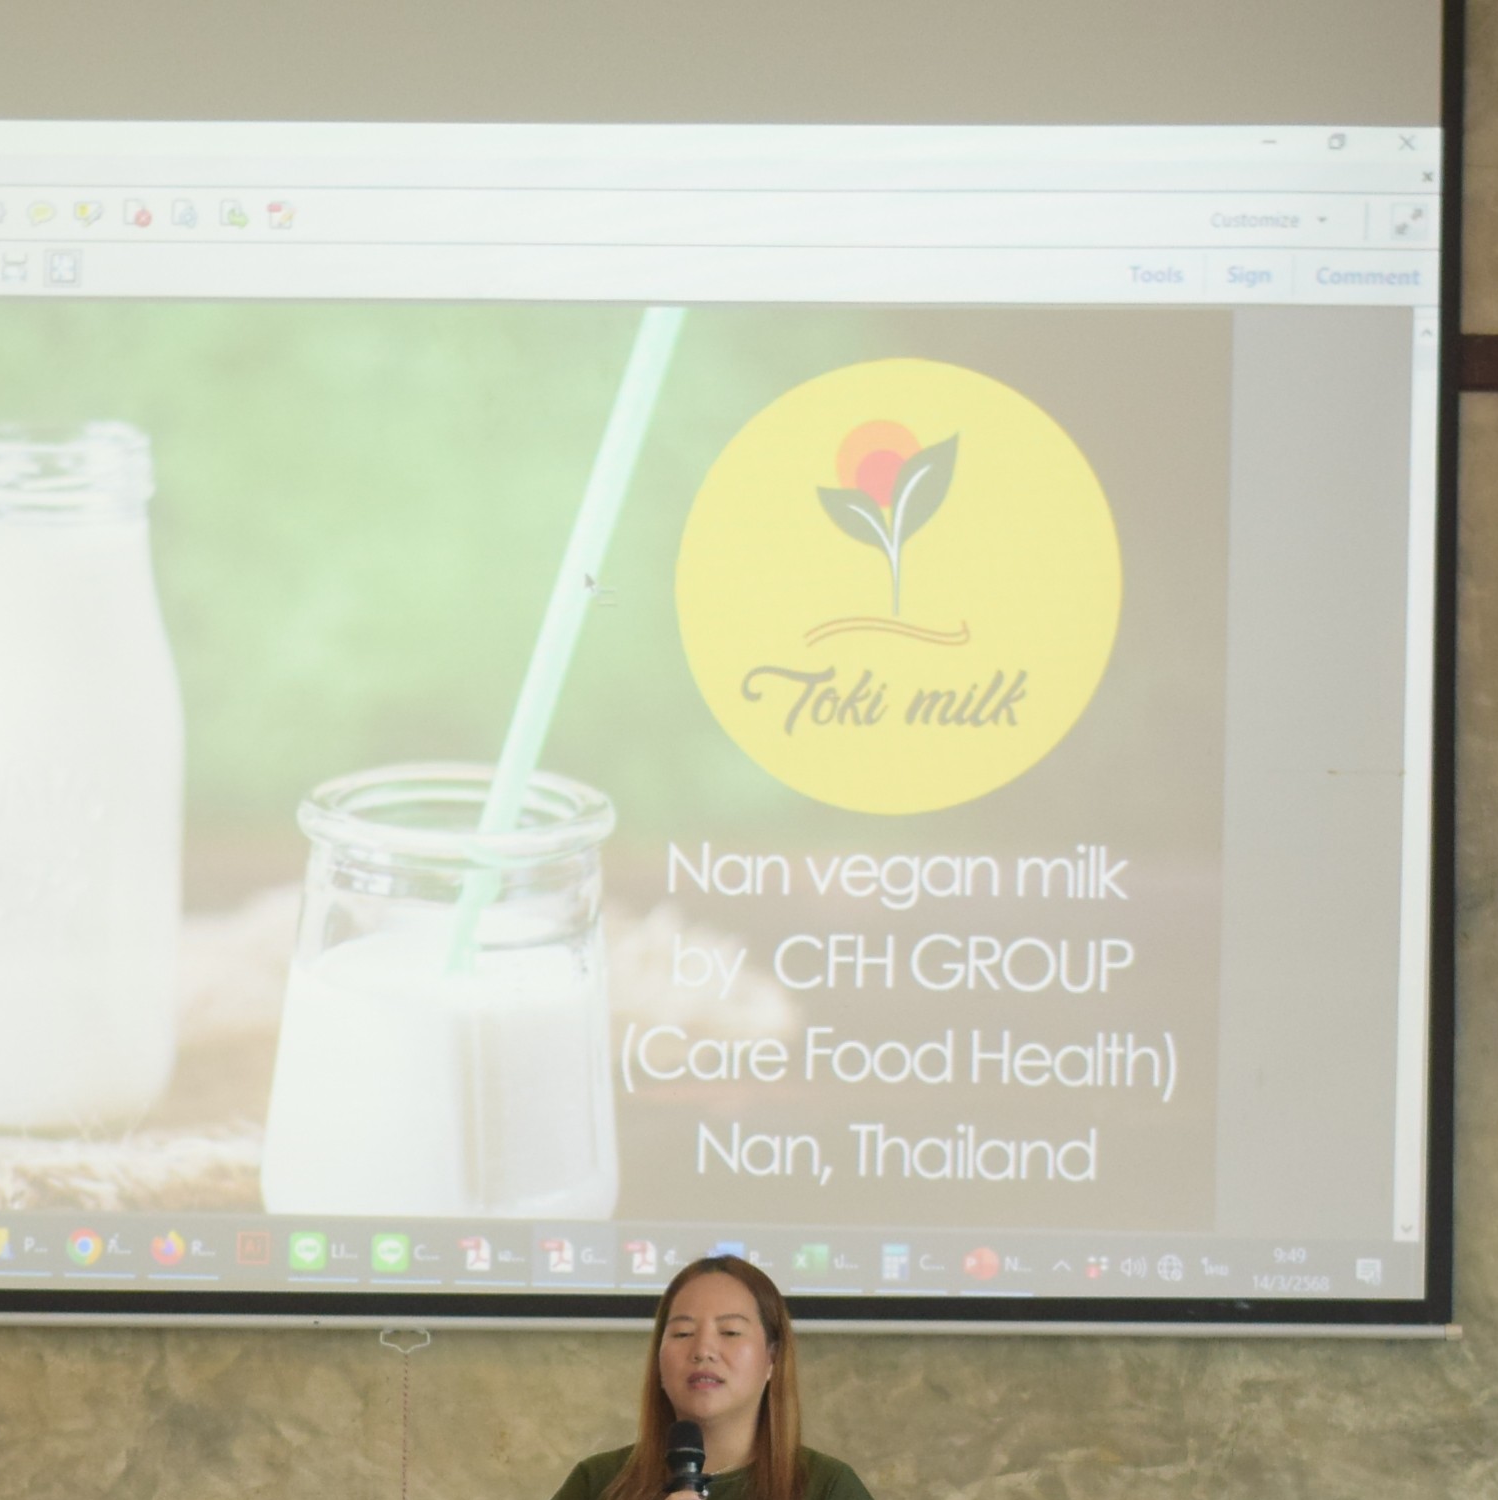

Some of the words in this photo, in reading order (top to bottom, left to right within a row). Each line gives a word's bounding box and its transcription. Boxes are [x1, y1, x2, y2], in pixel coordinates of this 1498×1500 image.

[1210, 212, 1300, 229] Customize
[1129, 266, 1183, 284] Tools
[1227, 266, 1271, 288] Sign
[1315, 267, 1420, 286] Comment
[741, 666, 887, 736] Toki
[904, 670, 1027, 726] milk
[667, 842, 790, 896] Nan
[805, 853, 1000, 910] vegan
[1016, 844, 1130, 900] milk
[673, 935, 747, 999] by
[774, 934, 895, 989] CFH
[910, 935, 1135, 993] GROUP
[621, 1022, 789, 1093] (Care
[805, 1027, 954, 1083] Food
[970, 1030, 1178, 1103] Health)
[697, 1122, 833, 1186] Nan,
[848, 1123, 1097, 1181] Thailand
[1273, 1247, 1306, 1264] 9:49
[1252, 1275, 1330, 1293] 14/3/2568
